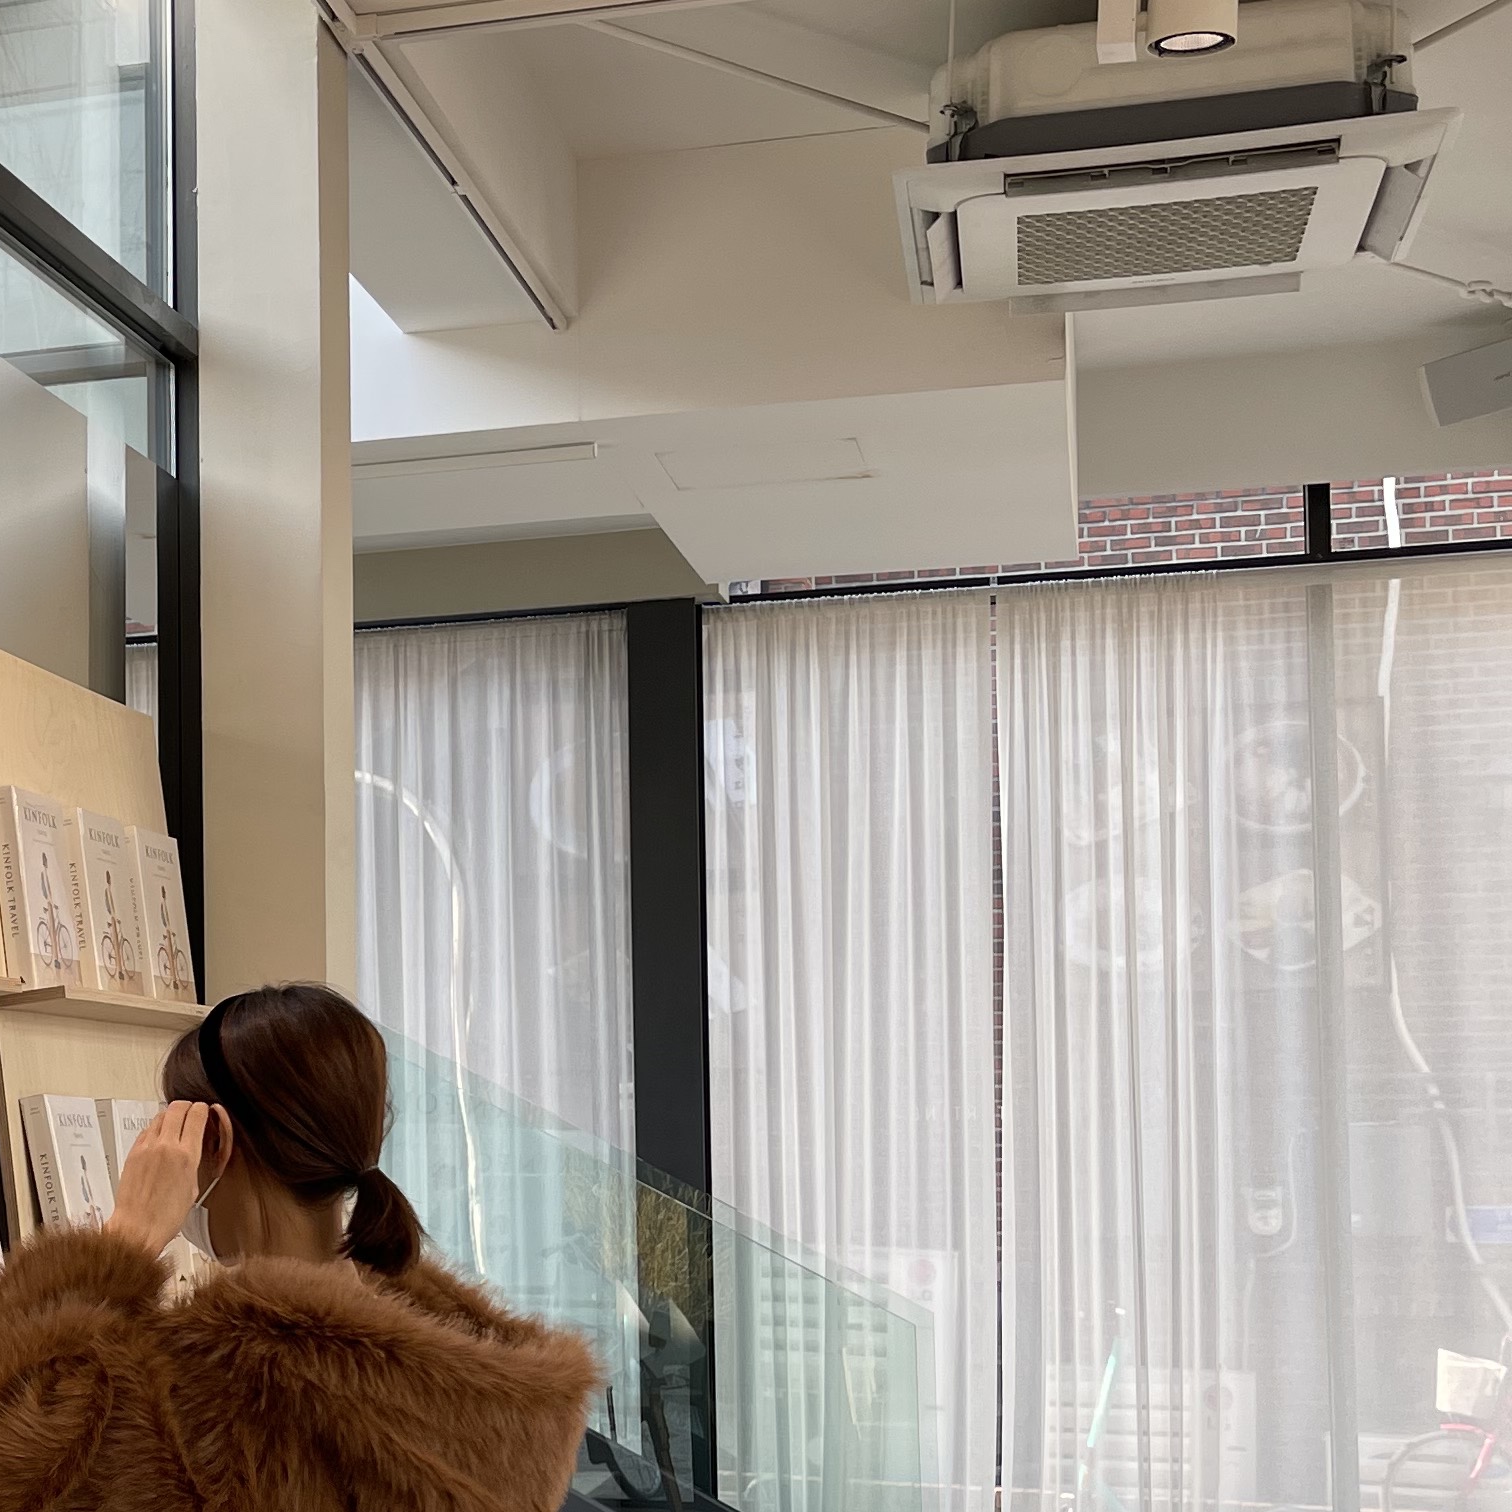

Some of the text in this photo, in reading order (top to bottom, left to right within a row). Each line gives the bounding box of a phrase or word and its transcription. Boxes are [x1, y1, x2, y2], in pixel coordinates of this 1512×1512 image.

[1, 843, 20, 939] KINFOLK TRAVEL
[68, 862, 87, 952] KINFOLK TRAVEL
[39, 1153, 56, 1205] KINFOLK
